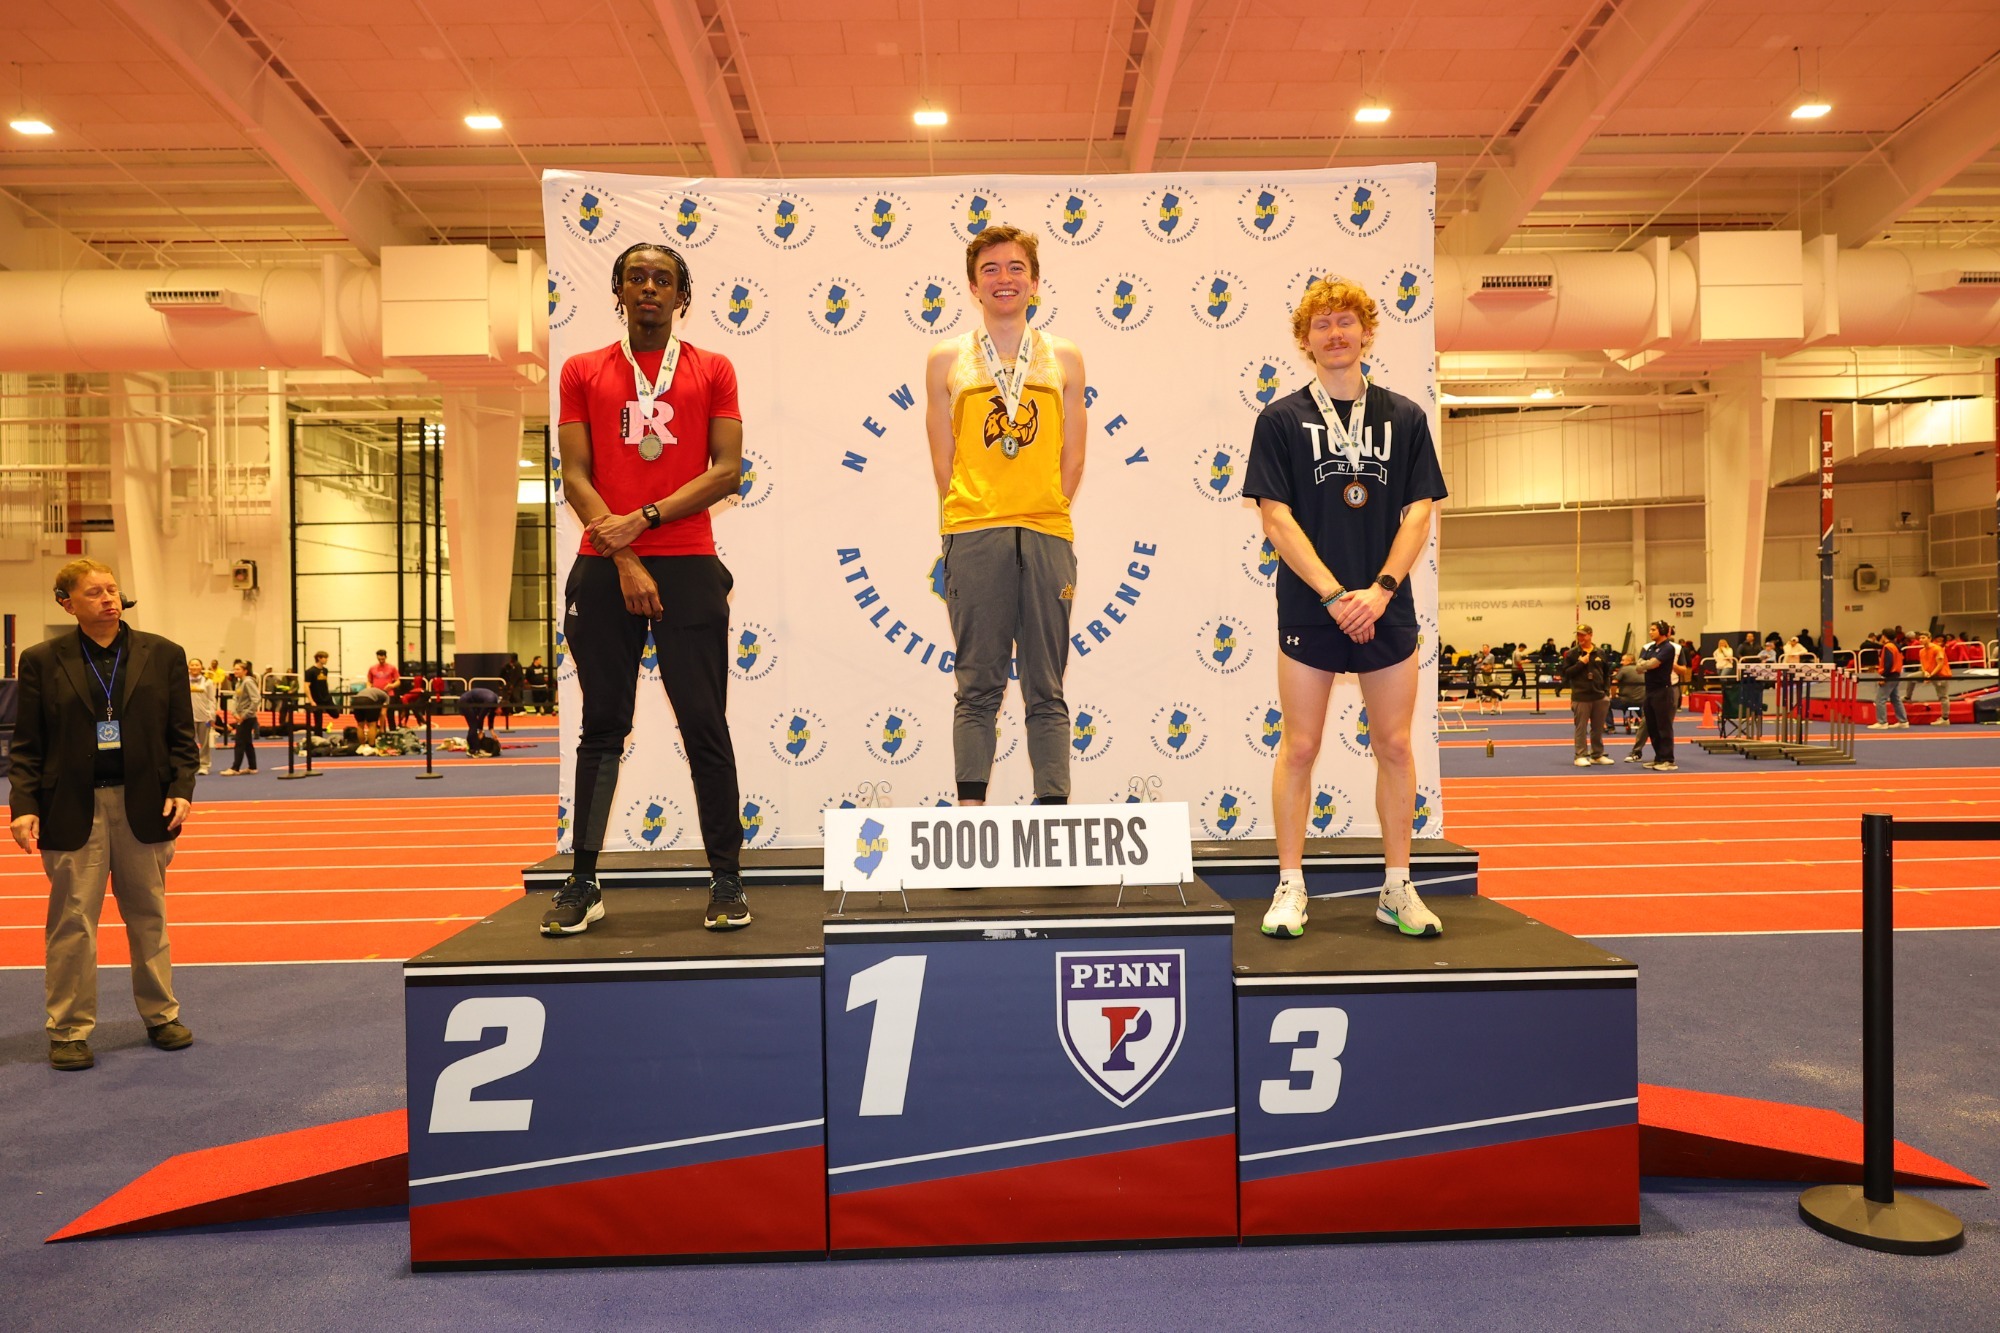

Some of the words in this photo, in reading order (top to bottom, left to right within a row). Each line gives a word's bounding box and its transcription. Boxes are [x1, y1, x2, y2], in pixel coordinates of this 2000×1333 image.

[562, 189, 574, 205] NEW
[584, 185, 618, 206] JERSEY
[1047, 193, 1059, 208] NEW
[1069, 188, 1101, 207] JERSEY
[1143, 191, 1155, 206] NEW
[1165, 185, 1197, 204] JERSEY
[1239, 189, 1251, 204] NEW
[1261, 184, 1294, 202] JERSEY
[1335, 185, 1348, 200] NEW
[1357, 179, 1390, 197] JERSEY
[660, 195, 673, 210] NEW
[684, 191, 716, 211] JERSEY
[758, 197, 770, 212] NEW
[780, 193, 813, 212] JERSEY
[855, 197, 867, 212] NEW
[877, 191, 910, 210] JERSEY
[1351, 201, 1374, 214] NJAC
[580, 207, 603, 220] NJAC
[677, 212, 700, 226] NJAC
[775, 214, 798, 228] NJAC
[872, 213, 895, 226] NJAC
[968, 210, 991, 224] NJAC
[1063, 209, 1086, 222] NJAC
[1159, 207, 1182, 220] NJAC
[1255, 205, 1278, 218] NJAC
[563, 217, 585, 241] ATHLETIC
[589, 220, 620, 244] CONFERENCE
[1046, 222, 1067, 244] ATHLETIC
[1072, 221, 1103, 246] CONFERENCE
[1142, 220, 1163, 242] ATHLETIC
[1167, 218, 1199, 243] CONFERENCE
[1238, 218, 1259, 240] ATHLETIC
[1263, 216, 1295, 241] CONFERENCE
[1334, 214, 1354, 236] ATHLETIC
[1359, 211, 1390, 237] CONFERENCE
[659, 223, 681, 246] ATHLETIC
[686, 225, 718, 248] CONFERENCE
[757, 226, 779, 248] ATHLETIC
[784, 226, 815, 250] CONFERENCE
[855, 225, 876, 247] ATHLETIC
[880, 224, 912, 249] CONFERENCE
[712, 282, 725, 297] NEW
[734, 277, 767, 297] JERSEY
[809, 283, 822, 297] NEW
[831, 277, 864, 296] JERSEY
[906, 281, 918, 296] NEW
[928, 276, 960, 295] JERSEY
[1097, 278, 1109, 293] NEW
[1119, 273, 1151, 291] JERSEY
[1192, 276, 1205, 291] NEW
[1214, 270, 1246, 289] JERSEY
[1113, 294, 1136, 308] NJAC
[1208, 292, 1231, 306] NJAC
[1397, 286, 1420, 300] NJAC
[729, 299, 752, 312] NJAC
[826, 299, 849, 312] NJAC
[922, 298, 945, 312] NJAC
[711, 311, 733, 334] ATHLETIC
[737, 311, 769, 335] CONFERENCE
[808, 311, 830, 334] ATHLETIC
[834, 311, 866, 335] CONFERENCE
[905, 310, 926, 333] ATHLETIC
[930, 309, 962, 334] CONFERENCE
[1096, 307, 1117, 329] ATHLETIC
[1121, 306, 1153, 331] CONFERENCE
[1191, 305, 1212, 327] ATHLETIC
[1216, 303, 1248, 329] CONFERENCE
[1257, 378, 1280, 392] NJAC
[625, 401, 677, 444] R
[841, 383, 915, 473] NEW
[1084, 386, 1149, 467] SEY
[1211, 466, 1233, 480] NJAC
[1822, 441, 1833, 499] PENN
[837, 547, 957, 673] ATHLETIC
[1459, 600, 1508, 610] THROWS
[1512, 599, 1543, 608] AREA
[1586, 600, 1611, 611] 108
[1668, 597, 1695, 608] 109
[1197, 621, 1210, 636] NEW
[1219, 616, 1251, 635] JERSEY
[738, 644, 761, 658] NJAC
[1213, 638, 1236, 652] NJAC
[1196, 650, 1217, 672] ATHLETIC
[1222, 649, 1253, 674] CONFERENCE
[771, 713, 783, 728] NEW
[793, 708, 825, 727] JERSEY
[867, 712, 879, 727] NEW
[888, 707, 921, 726] JERSEY
[1152, 707, 1164, 723] NEW
[1173, 702, 1206, 721] JERSEY
[787, 730, 810, 744] NJAC
[883, 729, 906, 742] NJAC
[1168, 724, 1191, 738] NJAC
[770, 742, 791, 764] ATHLETIC
[795, 741, 827, 766] CONFERENCE
[865, 741, 887, 763] ATHLETIC
[891, 740, 922, 764] CONFERENCE
[1151, 736, 1172, 758] ATHLETIC
[1176, 735, 1207, 759] CONFERENCE
[1218, 807, 1241, 820] NJAC
[1313, 805, 1336, 818] NJAC
[643, 817, 666, 830] NJAC
[856, 838, 889, 858] NJAC
[911, 820, 1000, 870] 5000
[1012, 816, 1149, 868] METERS
[1070, 962, 1171, 989] PENN
[845, 955, 927, 1116] 1
[428, 996, 546, 1133] 2
[1259, 1007, 1349, 1114] 3
